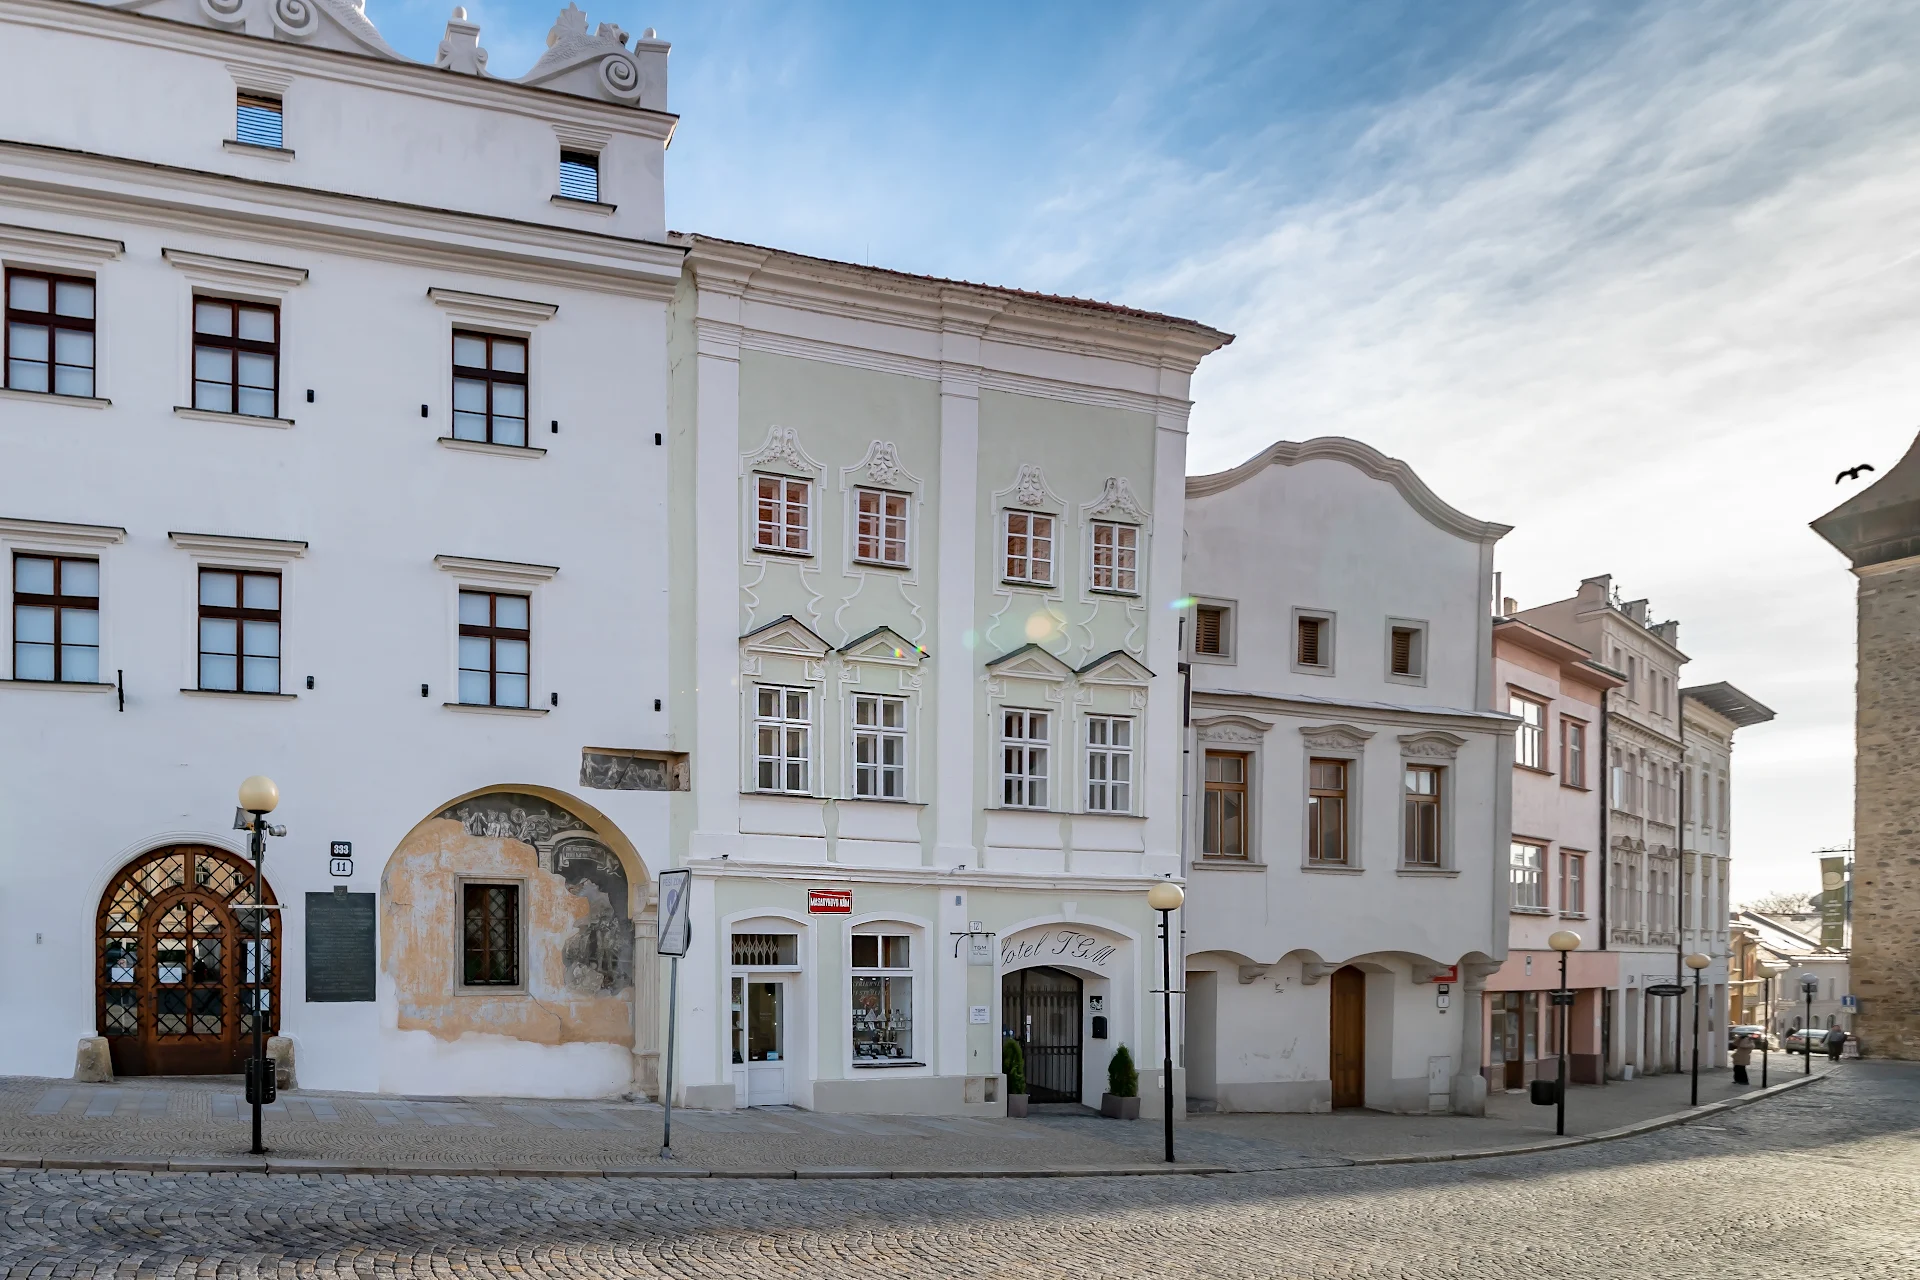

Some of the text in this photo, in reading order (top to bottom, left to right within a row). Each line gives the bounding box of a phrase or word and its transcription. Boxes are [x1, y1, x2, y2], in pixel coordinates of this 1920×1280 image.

[334, 844, 348, 854] 333
[336, 862, 346, 871] 11
[973, 922, 980, 931] 12
[1052, 931, 1116, 966] TGM
